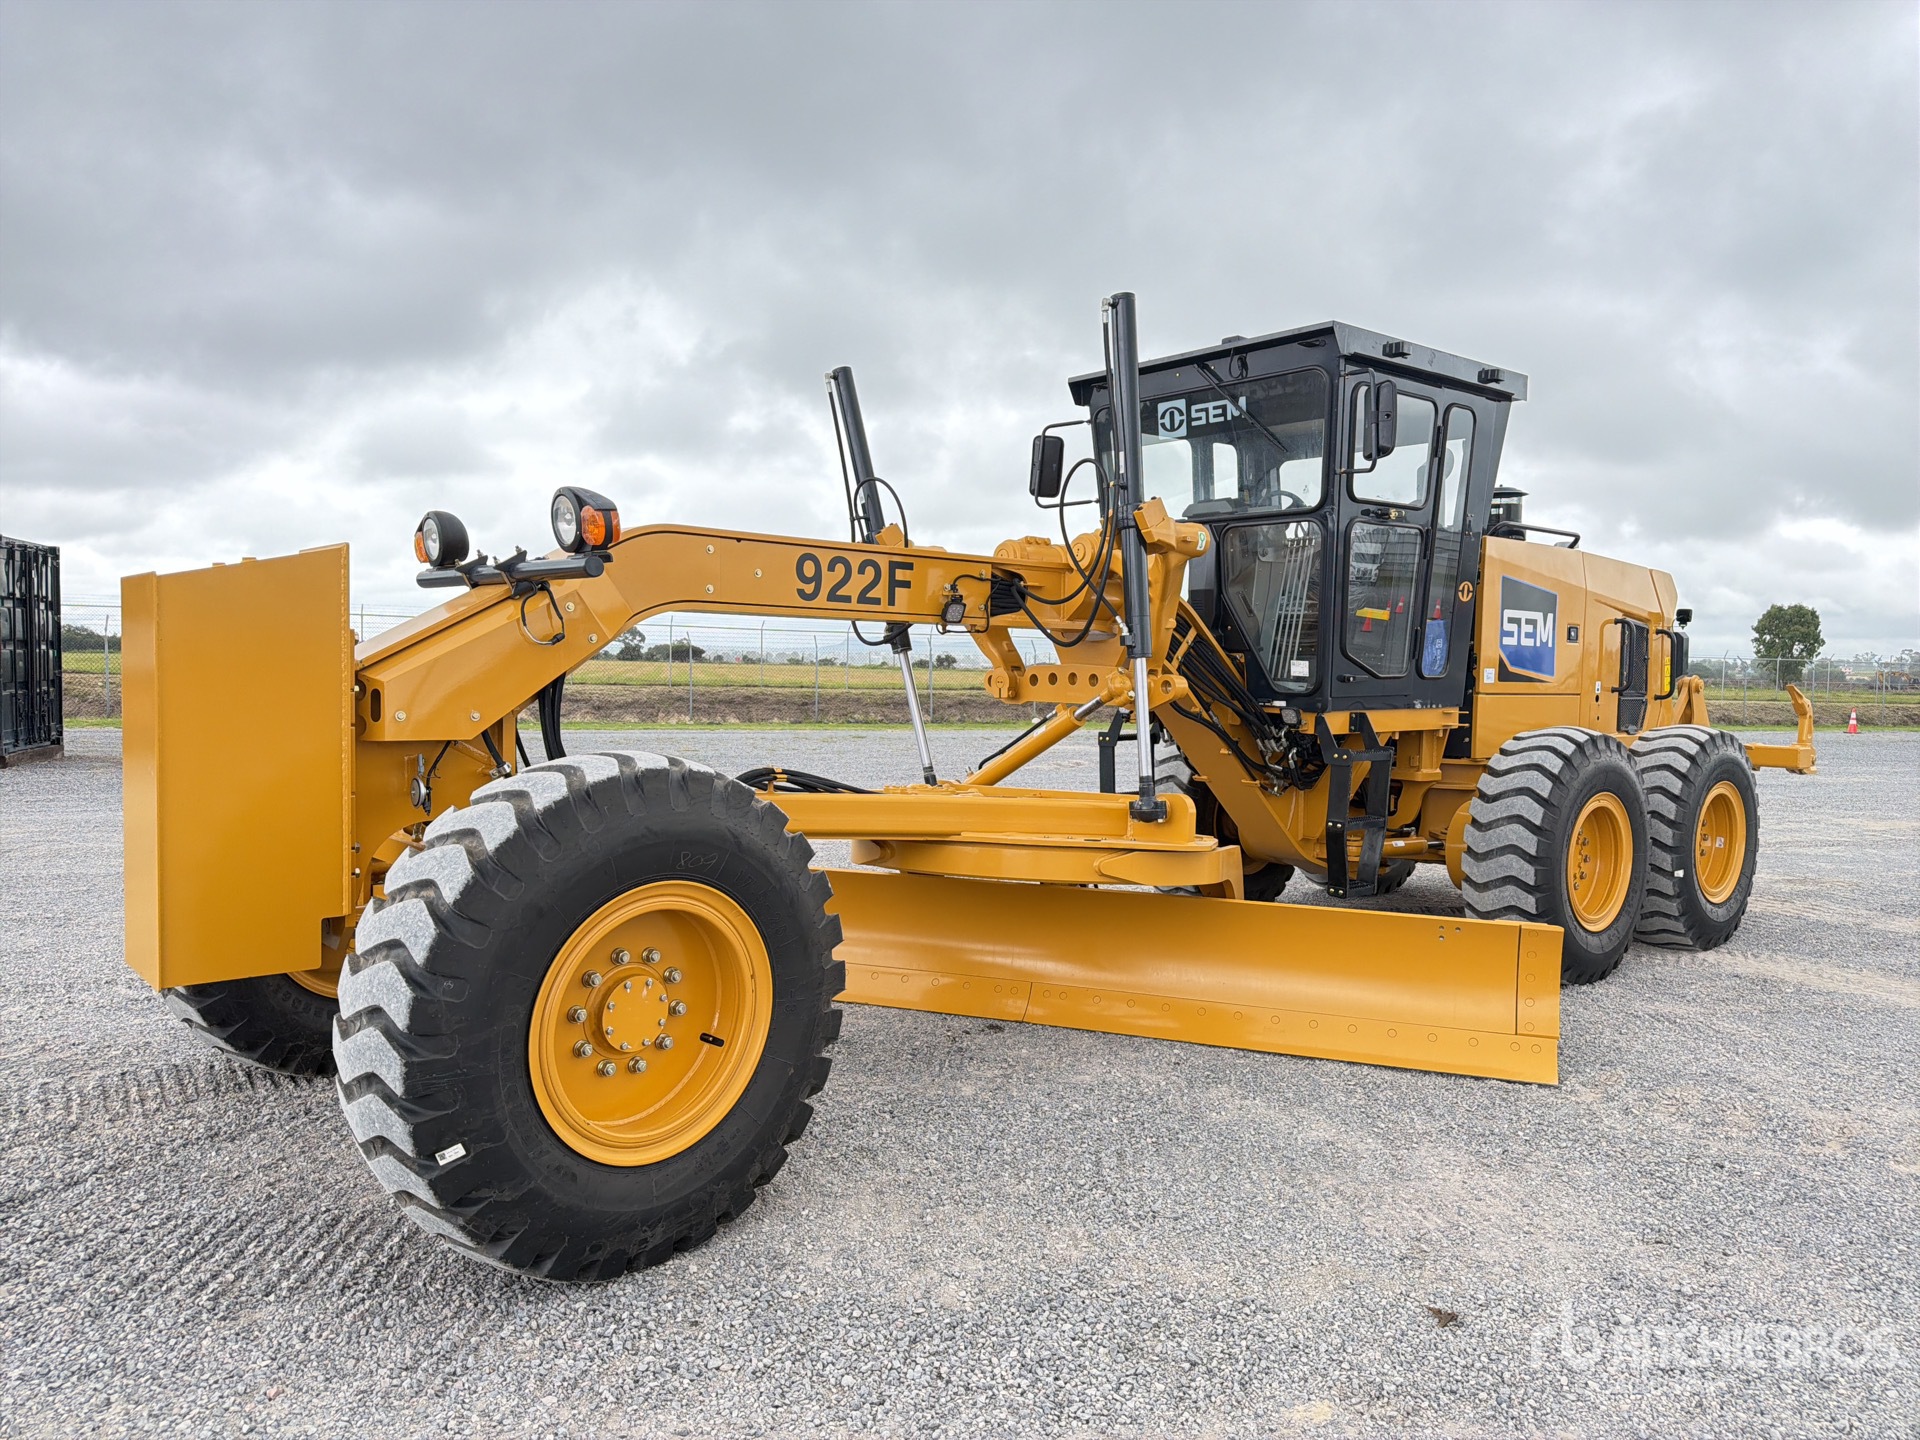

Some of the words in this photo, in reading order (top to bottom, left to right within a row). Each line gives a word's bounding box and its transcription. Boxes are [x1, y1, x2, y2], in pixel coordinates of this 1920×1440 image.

[1191, 396, 1247, 427] SEM
[795, 552, 915, 607] 922F
[1502, 608, 1554, 648] SEM
